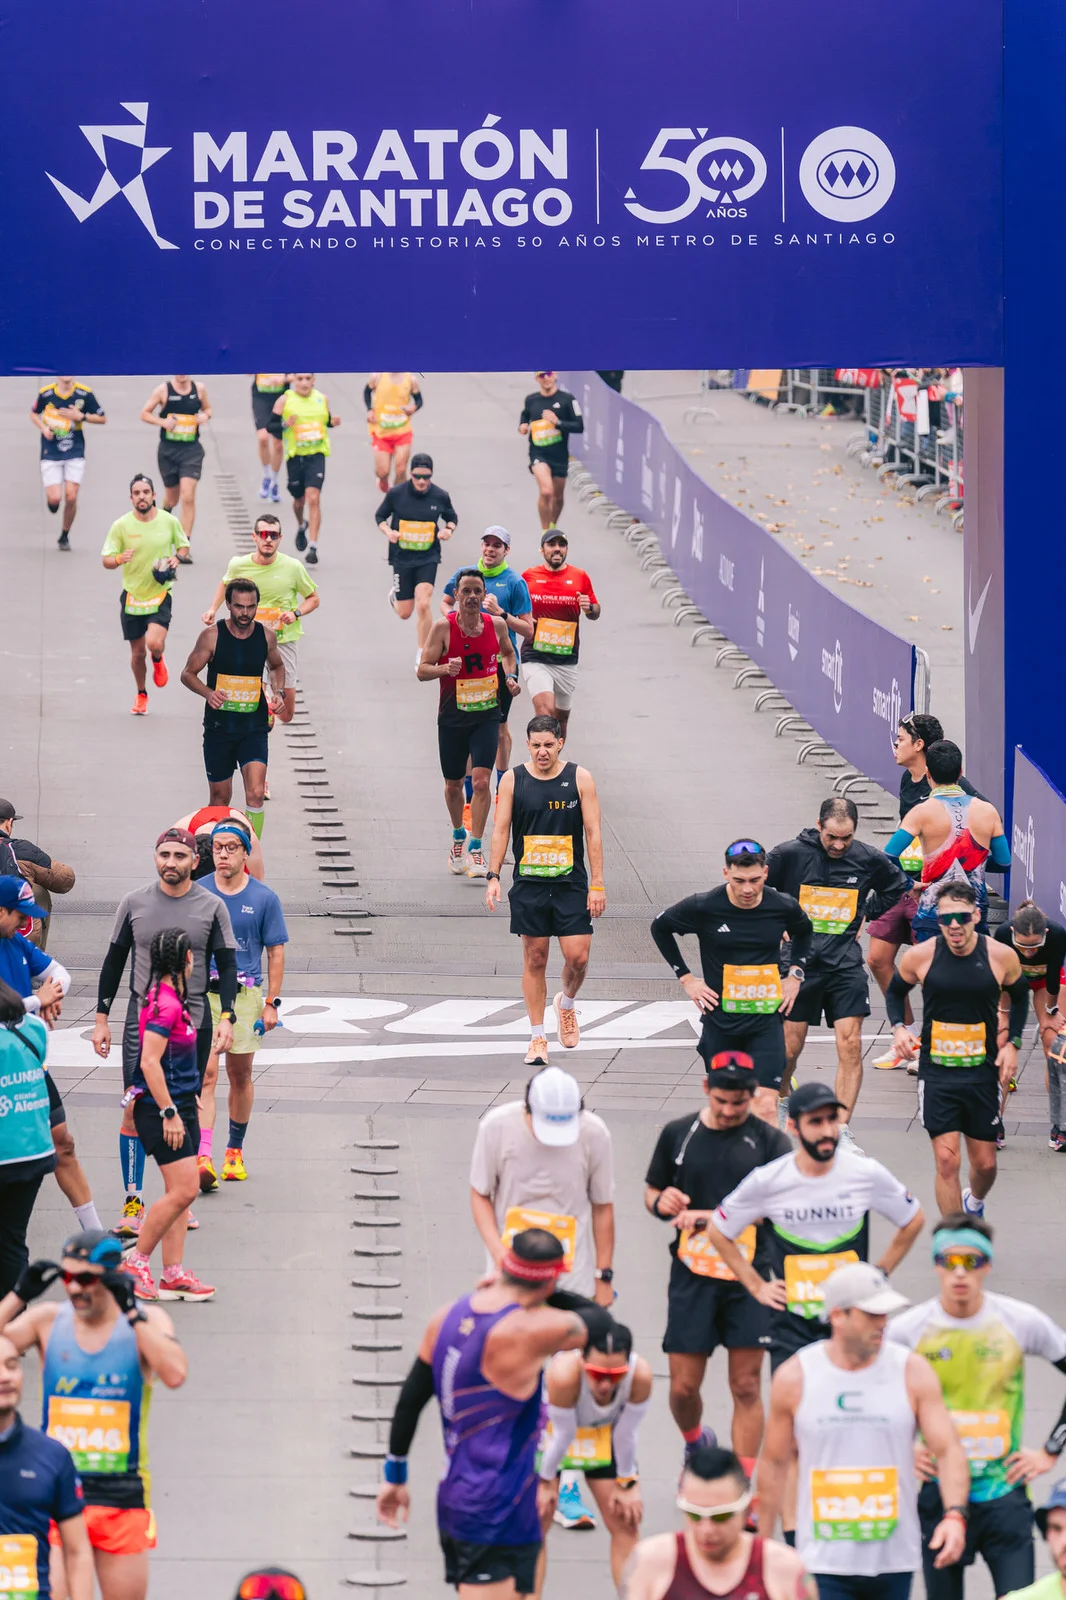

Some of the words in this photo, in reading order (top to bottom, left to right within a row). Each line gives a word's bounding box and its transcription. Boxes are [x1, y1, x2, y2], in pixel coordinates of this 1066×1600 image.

[194, 114, 568, 183] MARATÓN
[194, 191, 265, 229] DE
[282, 187, 573, 229] SANTIAGO
[706, 206, 748, 219] AÑOS
[194, 238, 357, 251] CONECTANDO
[374, 237, 501, 248] HISTORIAS
[518, 237, 543, 248] 50
[559, 233, 621, 247] AÑOS
[638, 234, 715, 247] METRO
[732, 234, 758, 246] DE
[775, 233, 896, 246] SANTIAGO
[728, 983, 778, 999] 12882
[784, 1206, 853, 1221] RUNNIT
